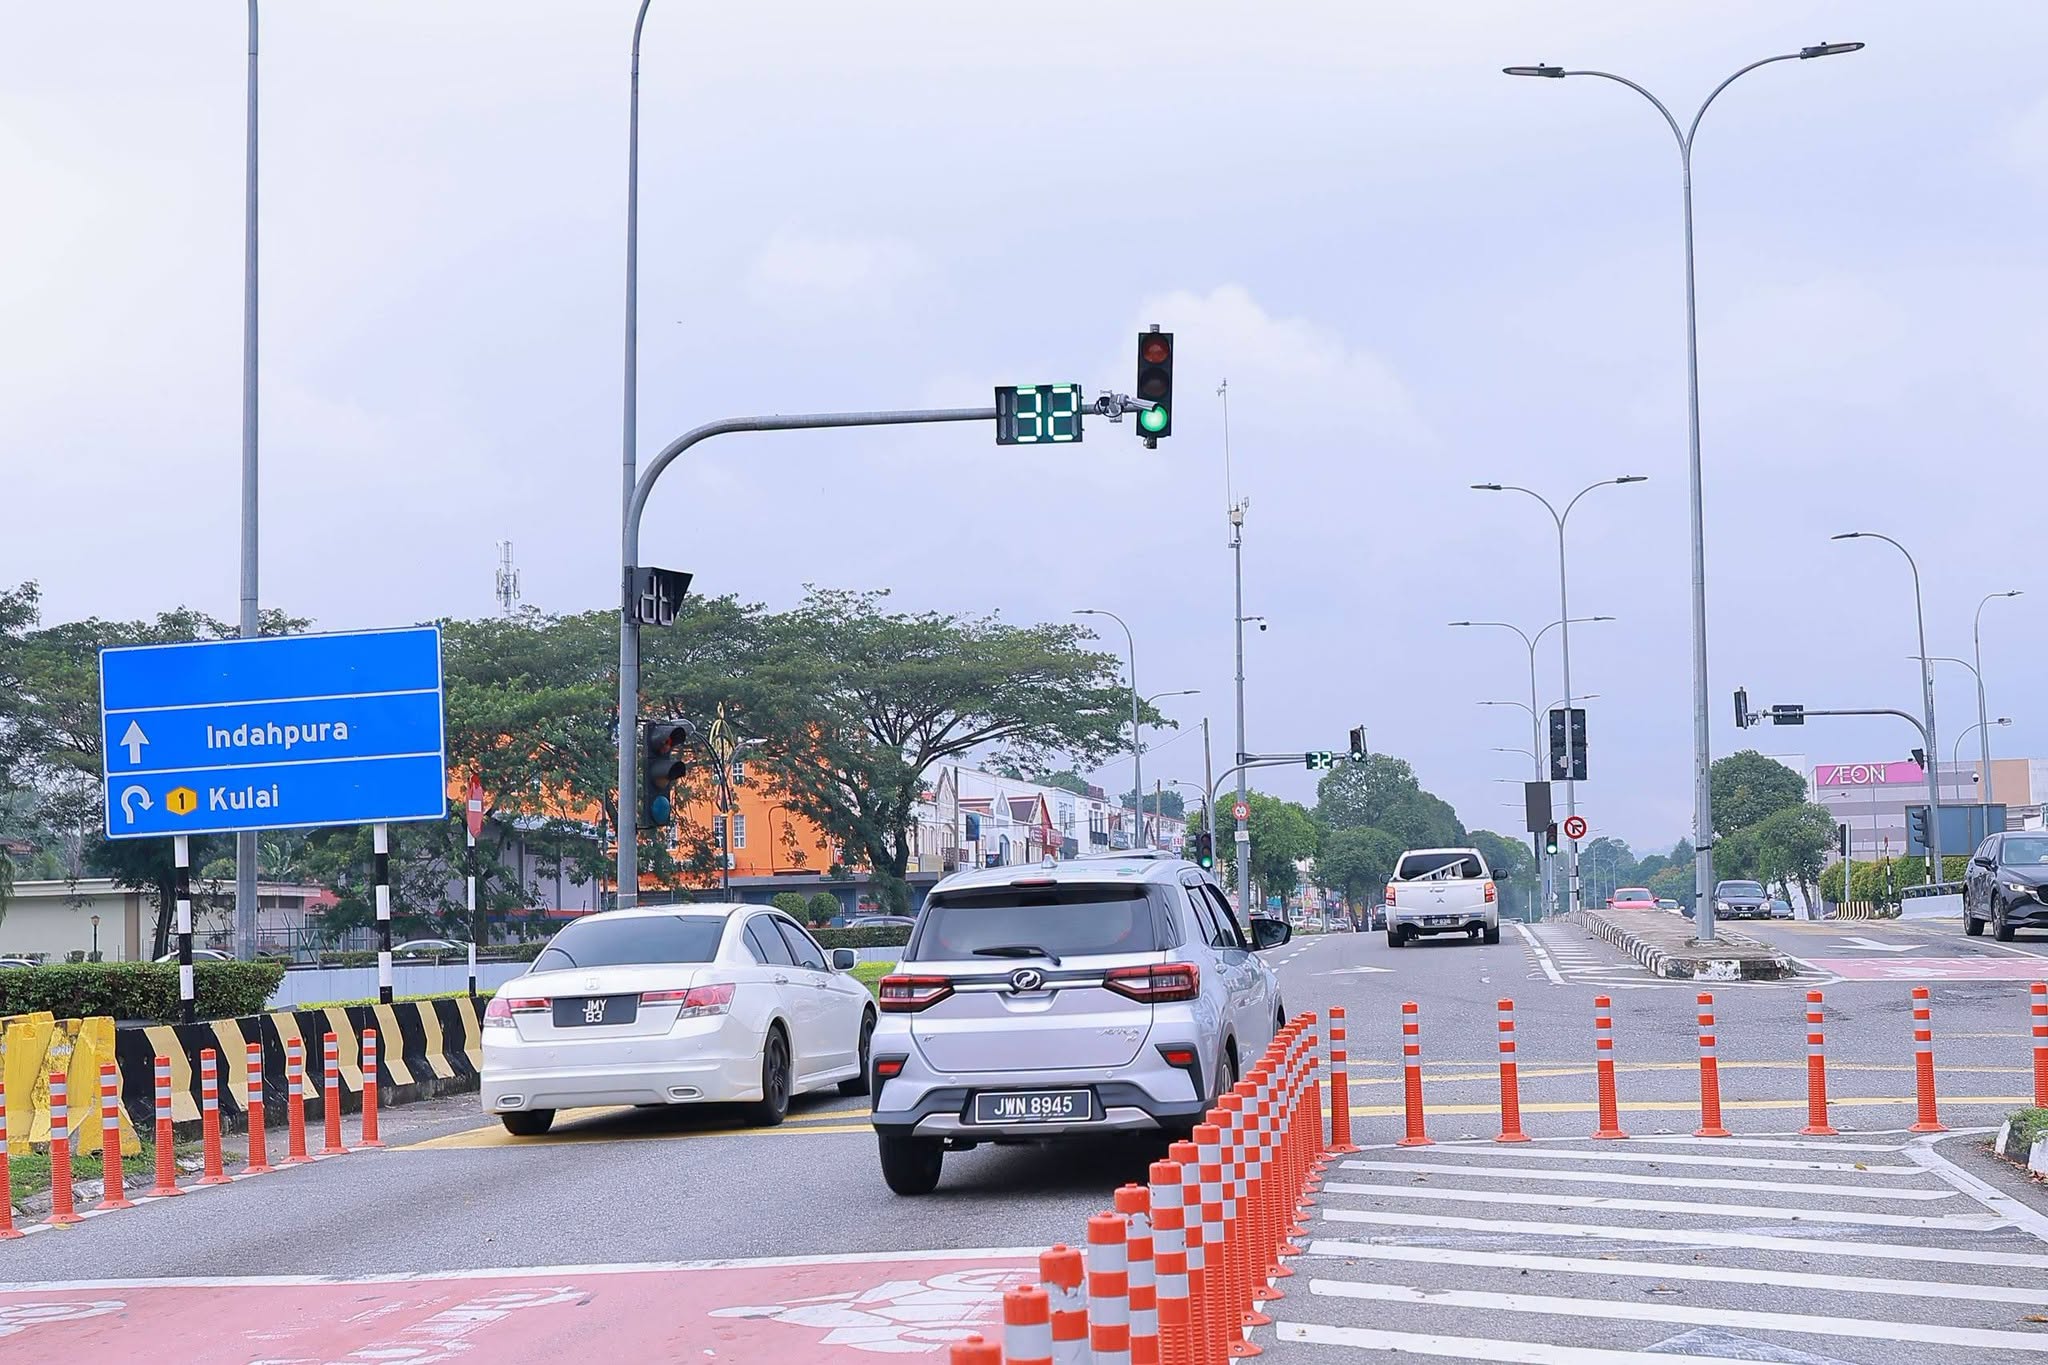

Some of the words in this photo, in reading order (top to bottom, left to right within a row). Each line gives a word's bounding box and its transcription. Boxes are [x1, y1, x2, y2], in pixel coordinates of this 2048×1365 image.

[1016, 385, 1078, 442] 32
[207, 722, 348, 750] Indahpura
[1311, 752, 1332, 769] 32
[209, 784, 279, 811] Kulai
[582, 999, 607, 1013] JMY
[585, 1011, 603, 1023] 83
[994, 1097, 1026, 1115] JWN
[1030, 1096, 1073, 1113] 8945
